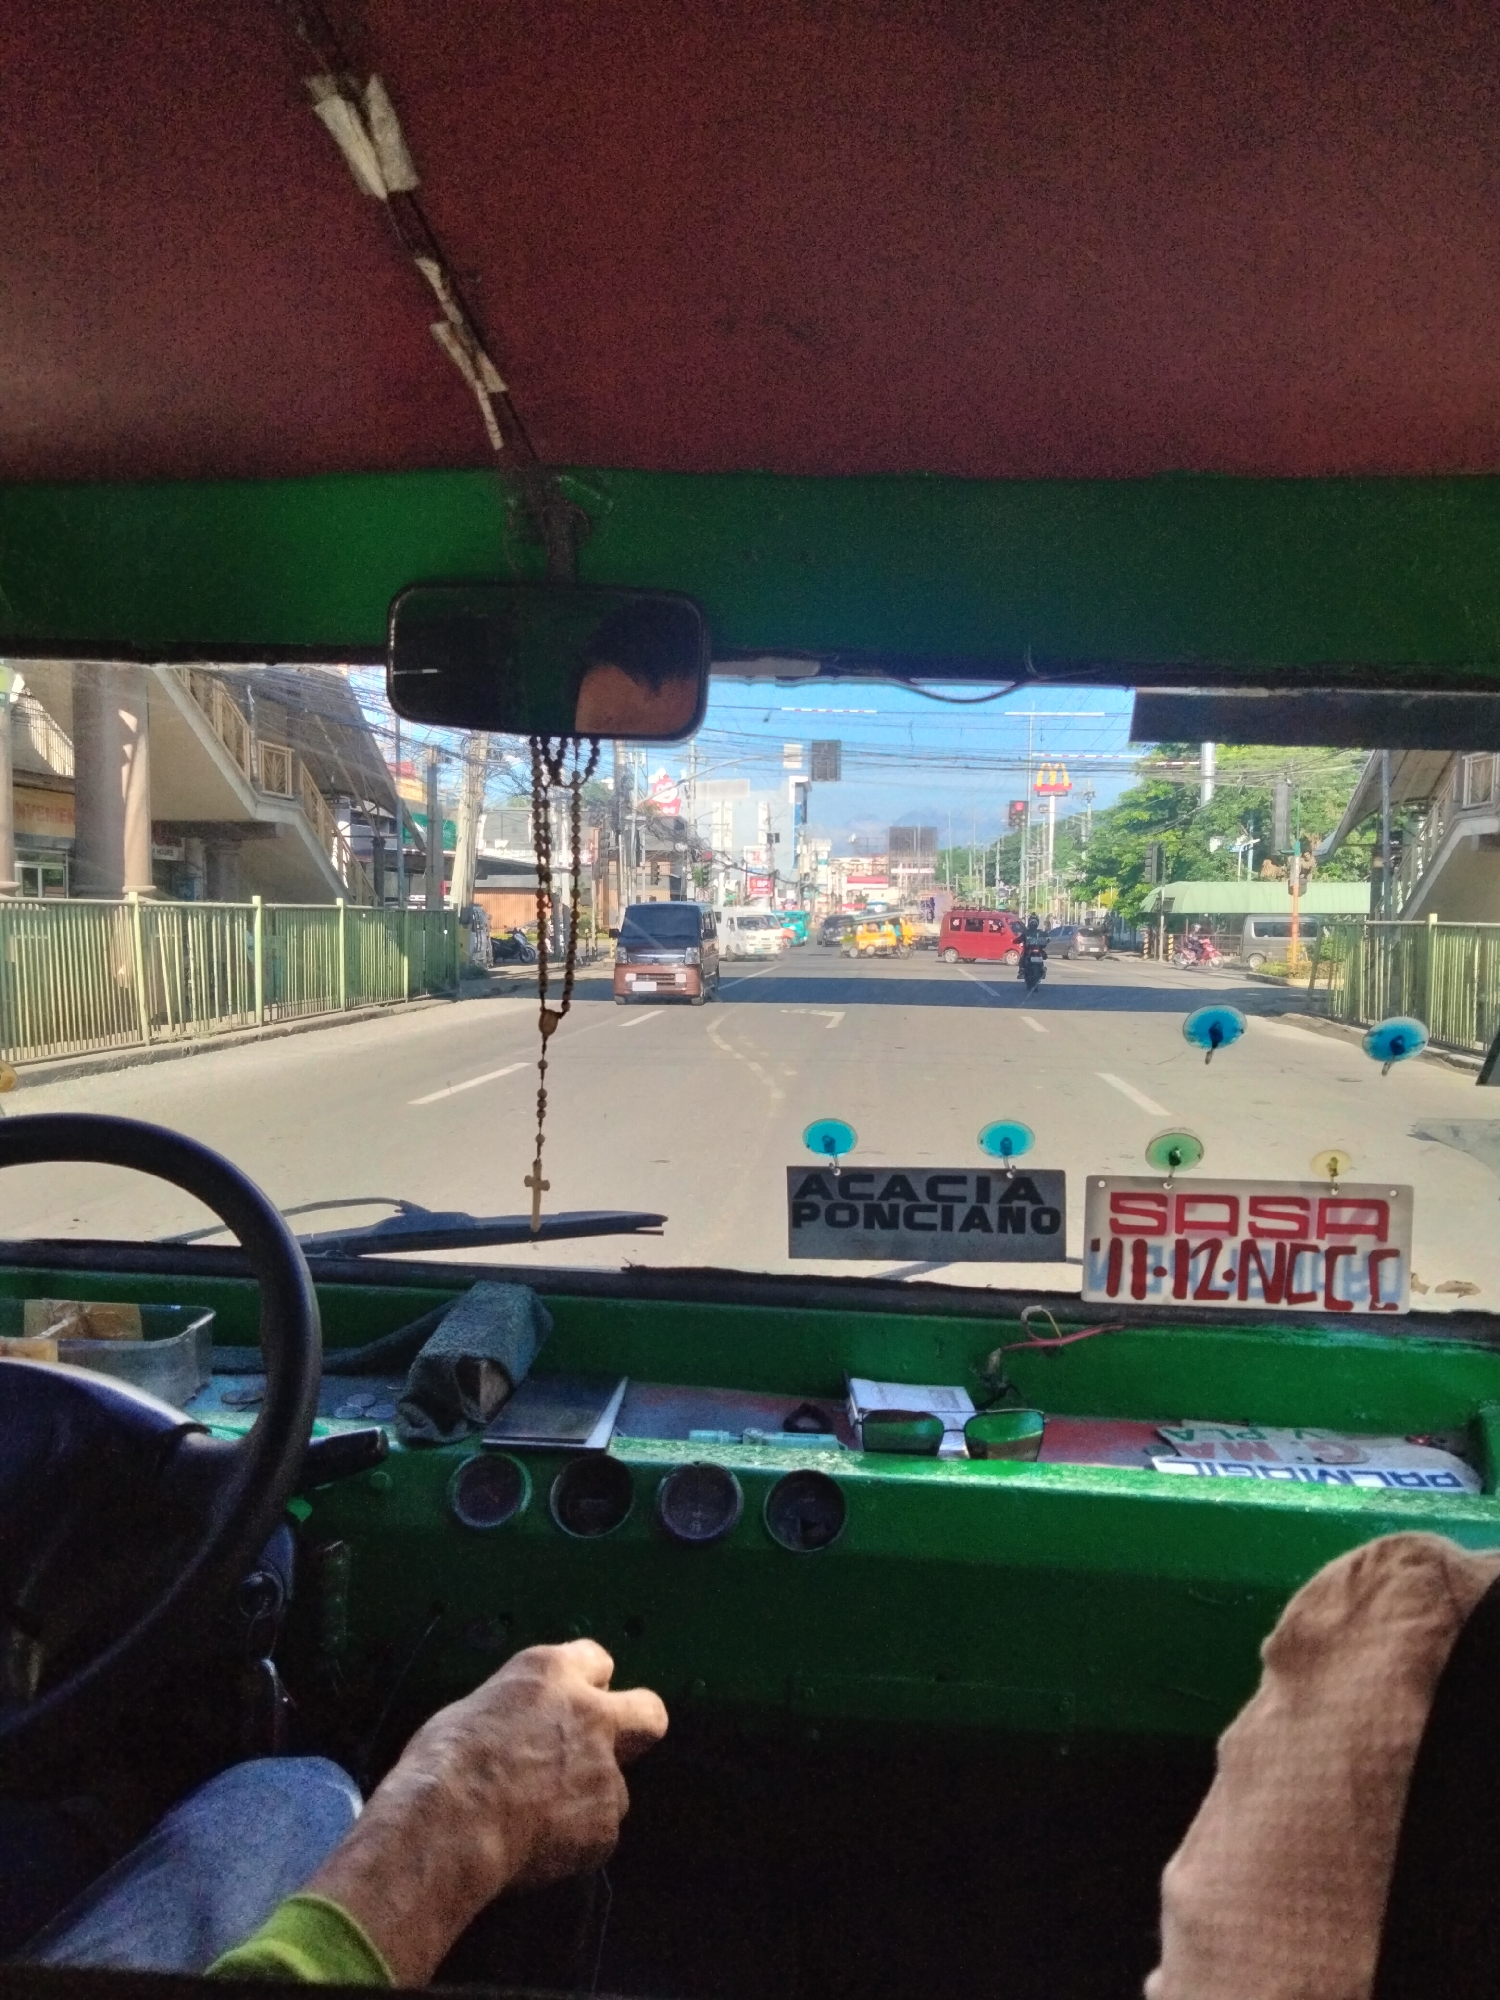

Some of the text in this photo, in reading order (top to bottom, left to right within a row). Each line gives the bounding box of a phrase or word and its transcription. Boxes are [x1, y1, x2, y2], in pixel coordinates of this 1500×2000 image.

[793, 1173, 1045, 1205] ACACIA
[791, 1202, 1061, 1235] PONCIANO
[1109, 1191, 1390, 1243] SASA
